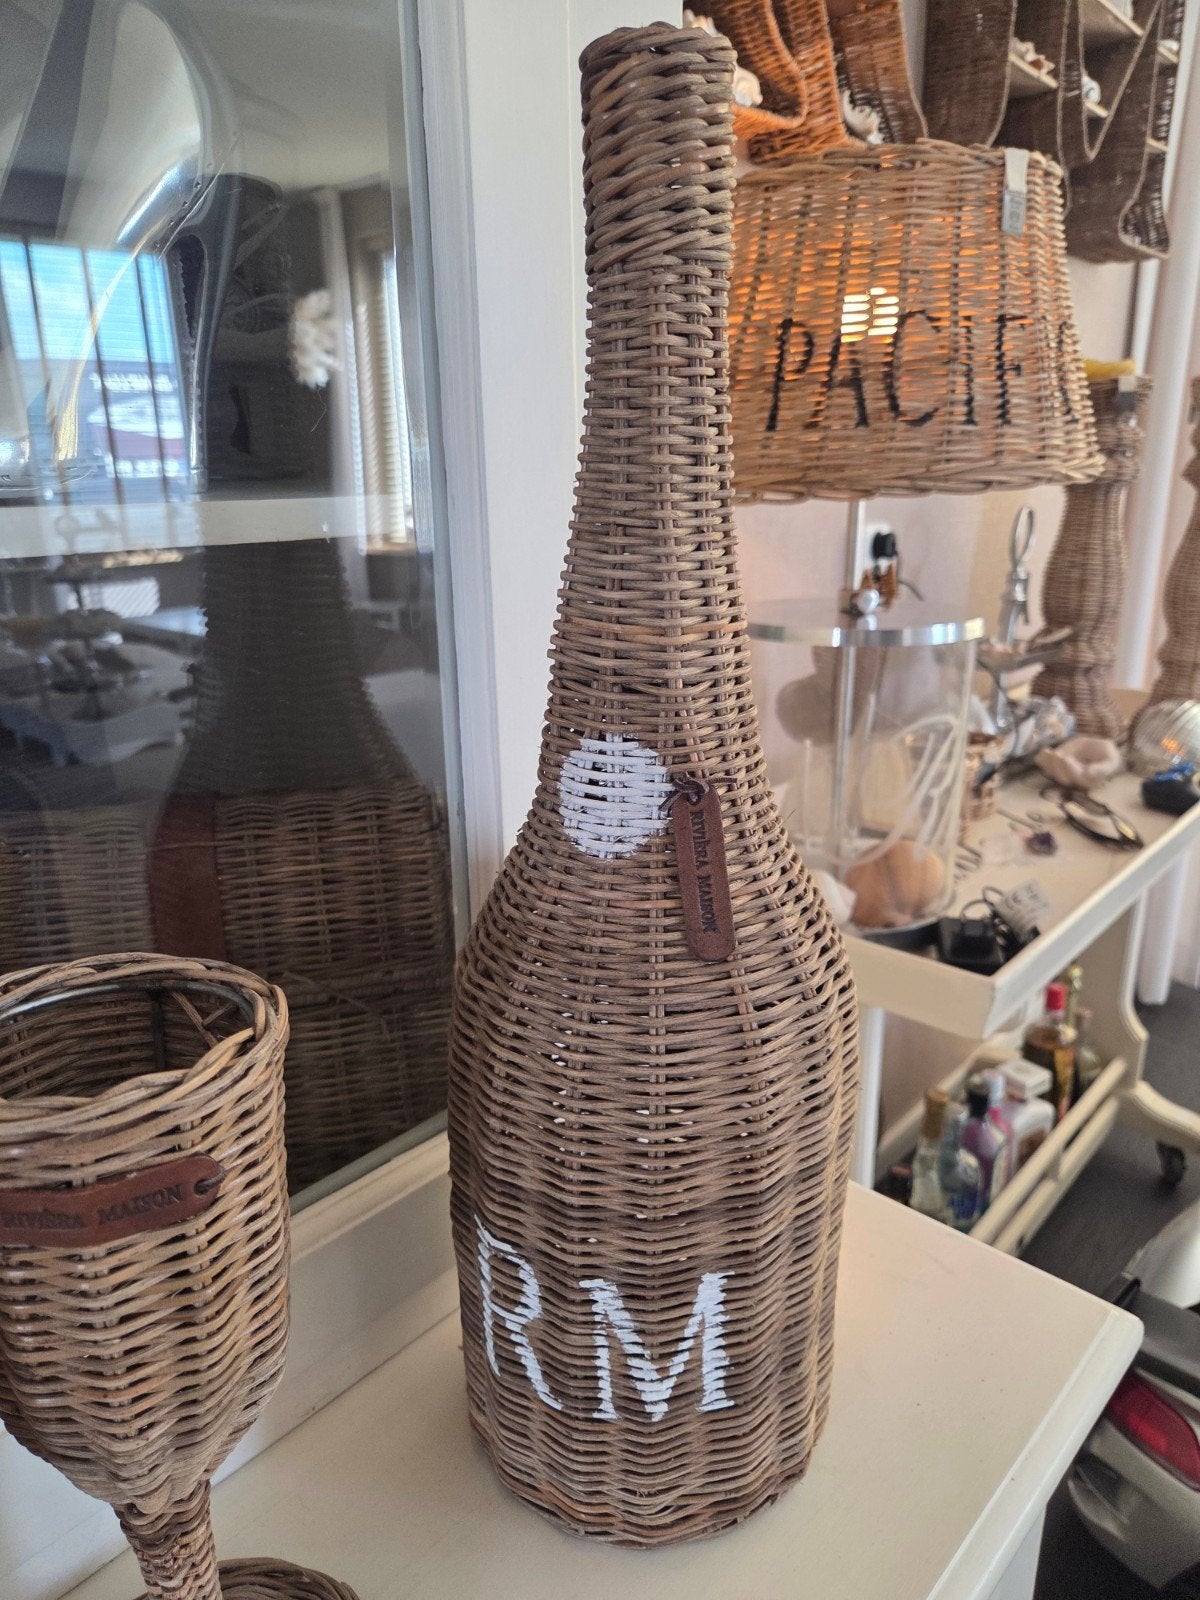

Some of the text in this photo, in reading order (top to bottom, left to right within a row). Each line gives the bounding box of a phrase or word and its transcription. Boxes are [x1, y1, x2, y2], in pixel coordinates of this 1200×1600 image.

[697, 875, 720, 933] MAISON
[97, 1184, 184, 1225] MAISON
[474, 1214, 735, 1422] RM
